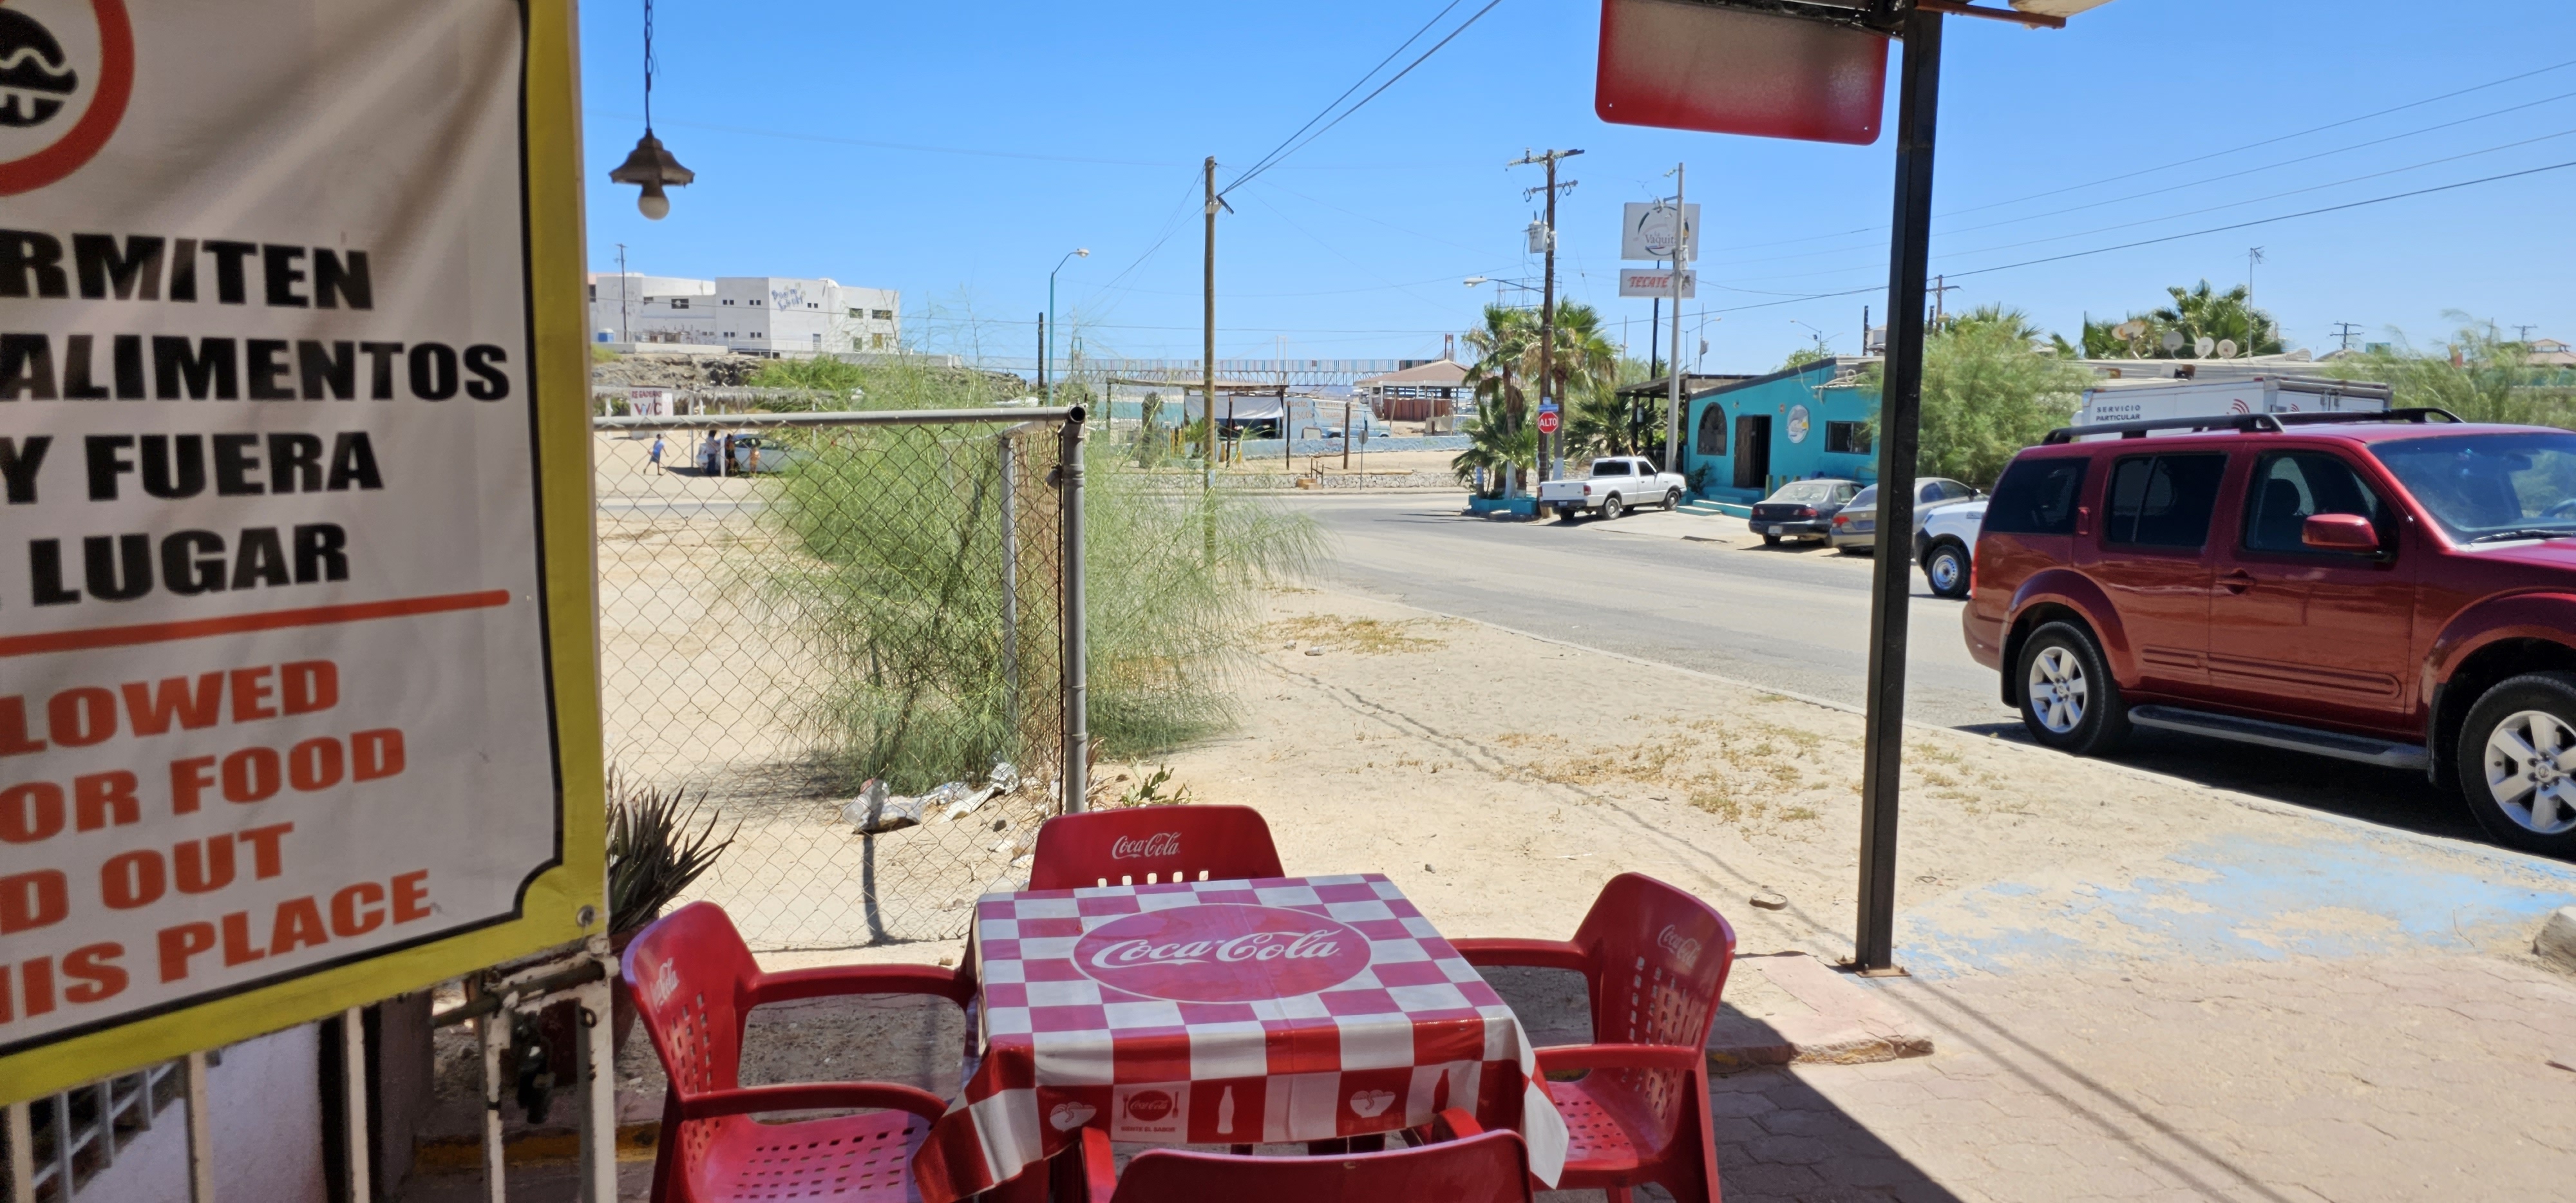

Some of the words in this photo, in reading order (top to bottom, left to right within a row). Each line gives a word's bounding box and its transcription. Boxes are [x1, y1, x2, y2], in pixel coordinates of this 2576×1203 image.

[1629, 276, 1670, 289] TECATE
[0, 333, 510, 402] ALIMENTOS
[1539, 418, 1557, 426] ALTO
[0, 436, 53, 504] Y
[85, 431, 383, 502] FUERA
[30, 523, 349, 605] LUGAR
[170, 728, 405, 816] FOOD
[100, 822, 294, 910] OUT
[1112, 832, 1181, 859] Coca-Cola
[157, 869, 433, 984] PLACE
[1092, 929, 1343, 968] Coca-Cola
